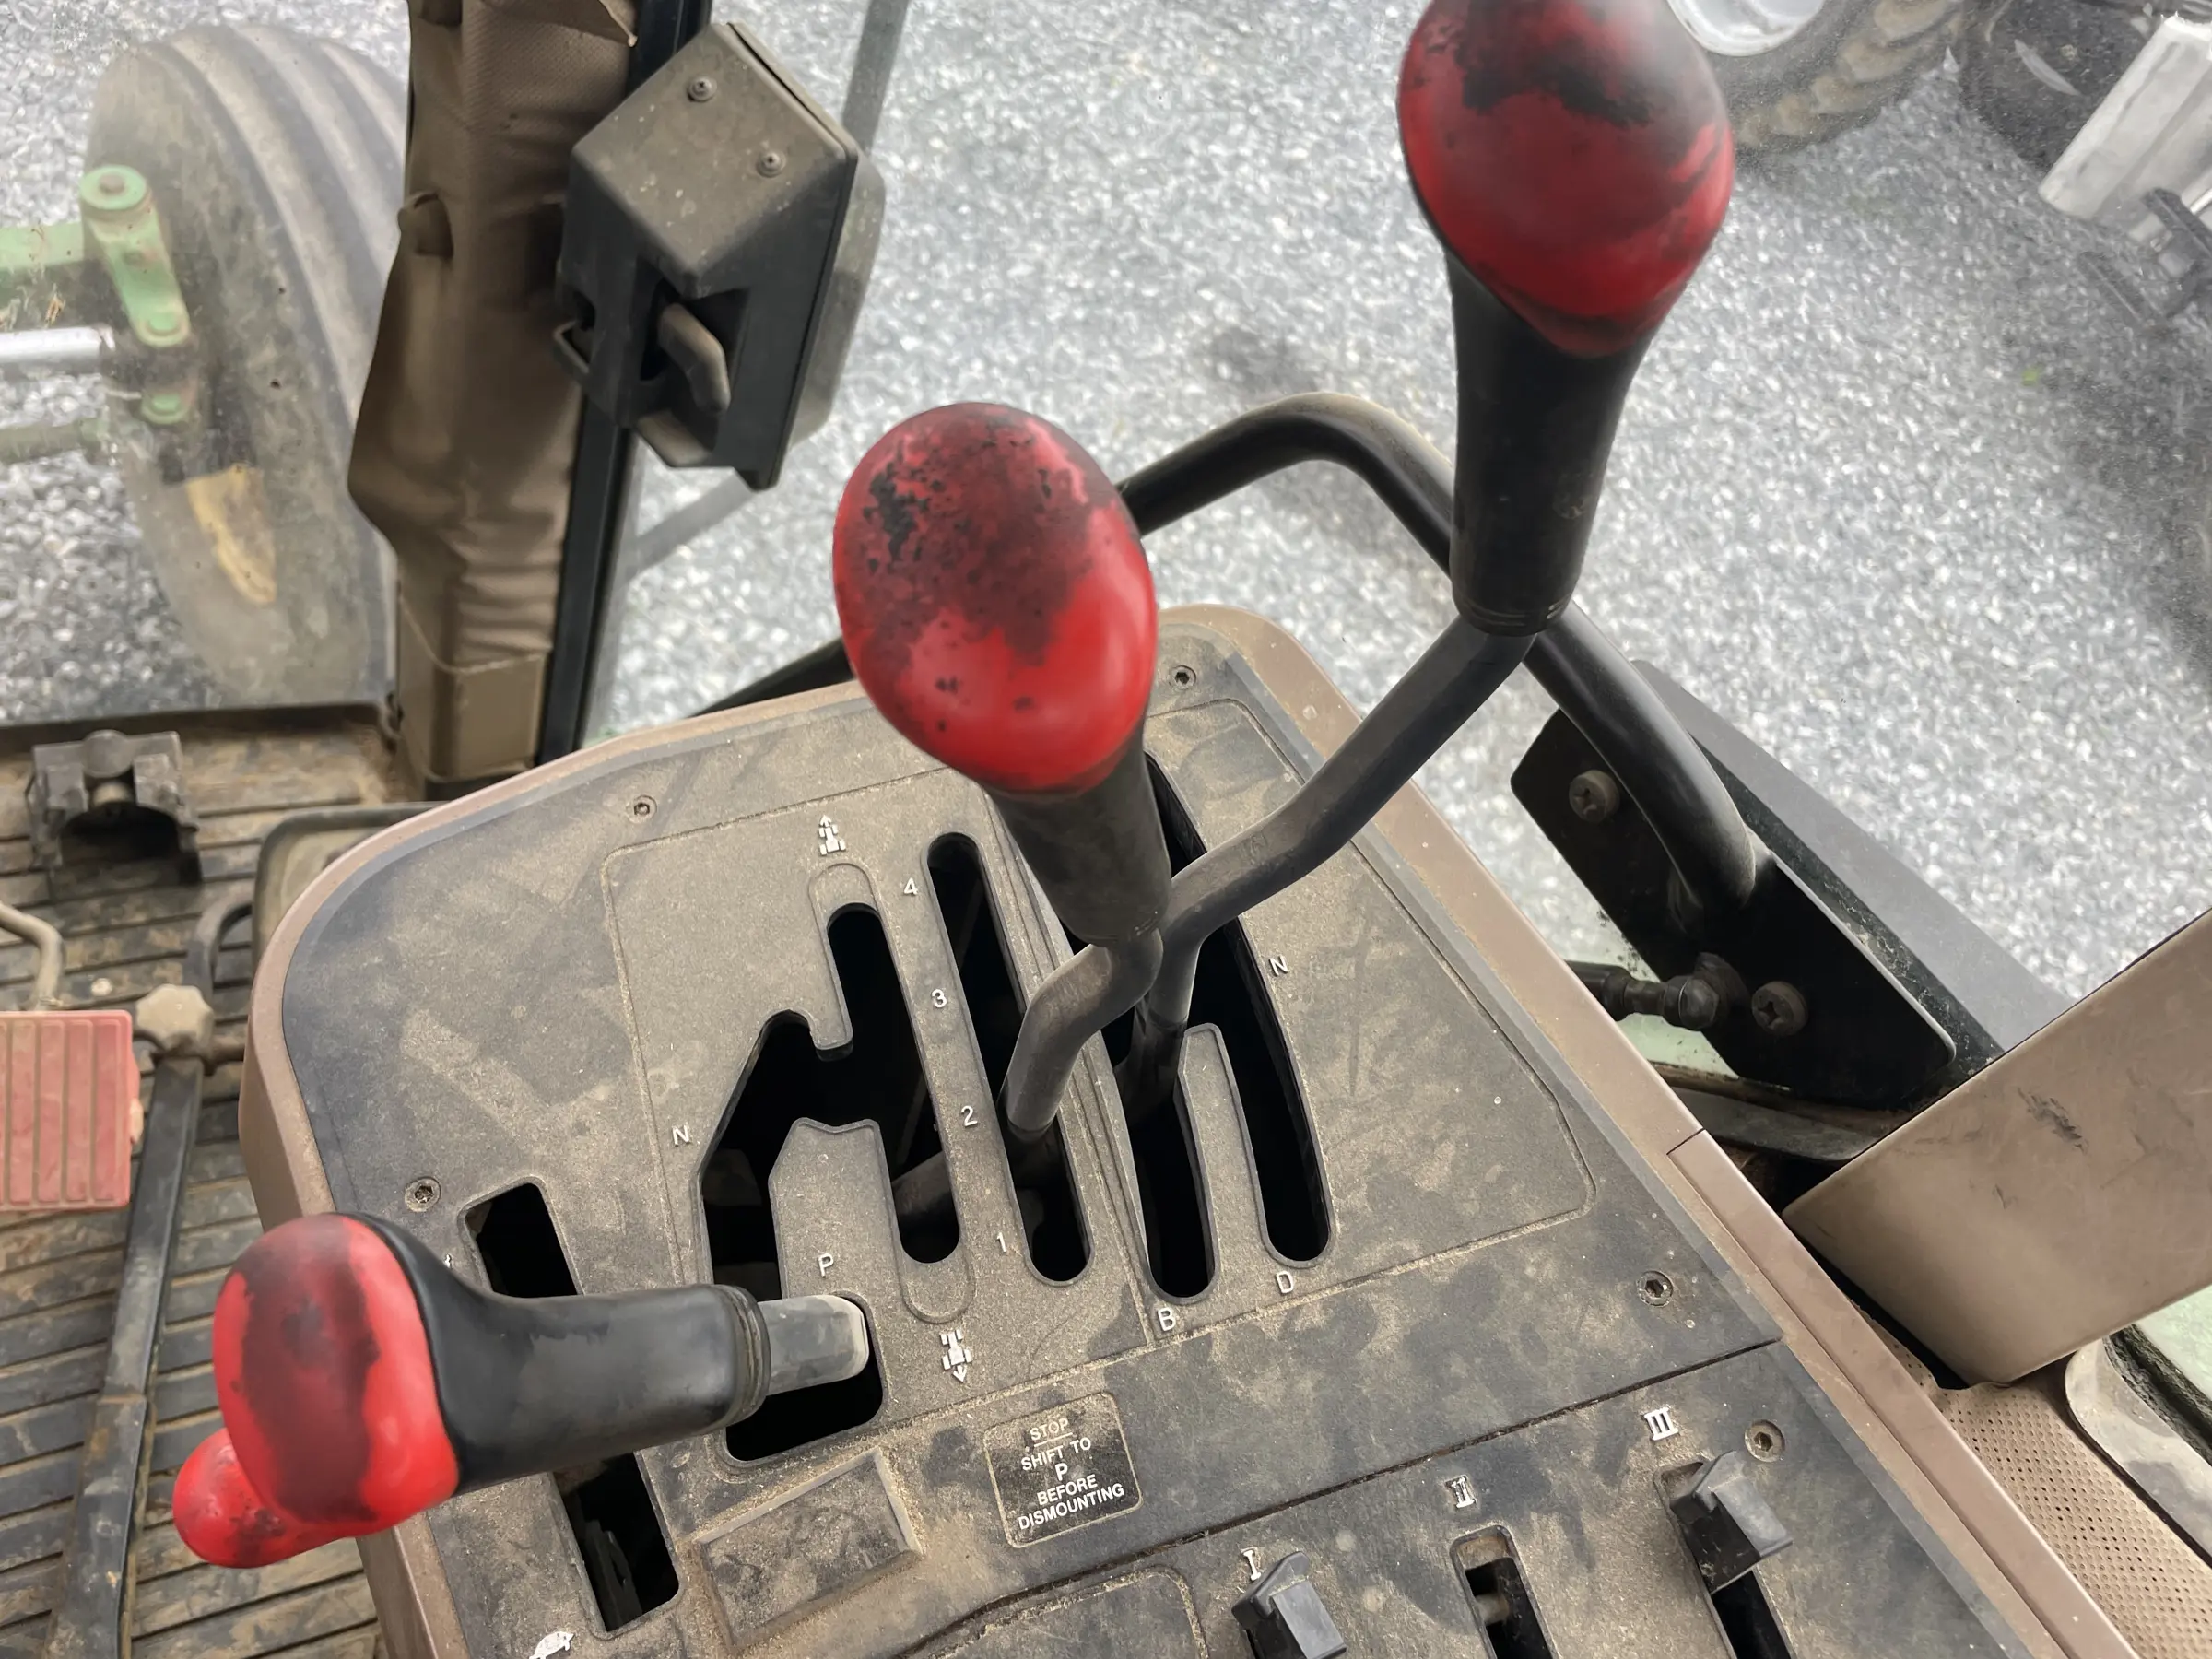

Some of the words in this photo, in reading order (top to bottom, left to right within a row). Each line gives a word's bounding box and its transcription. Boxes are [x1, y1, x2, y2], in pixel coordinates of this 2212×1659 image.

[904, 878, 918, 896] 4
[1270, 956, 1288, 974] N
[931, 989, 947, 1008] 3
[960, 1106, 978, 1127] 2
[672, 1125, 690, 1147] N
[996, 1232, 1008, 1253] 1
[818, 1253, 834, 1277] P
[1276, 1271, 1296, 1294] D
[1157, 1307, 1177, 1332] B
[1030, 1418, 1069, 1441] STOP
[1021, 1444, 1064, 1471] SHIFT
[1070, 1438, 1091, 1453] TO
[1055, 1463, 1068, 1481] P
[1037, 1475, 1098, 1505] BEFORE
[1018, 1483, 1124, 1529] DISMOUNTING
